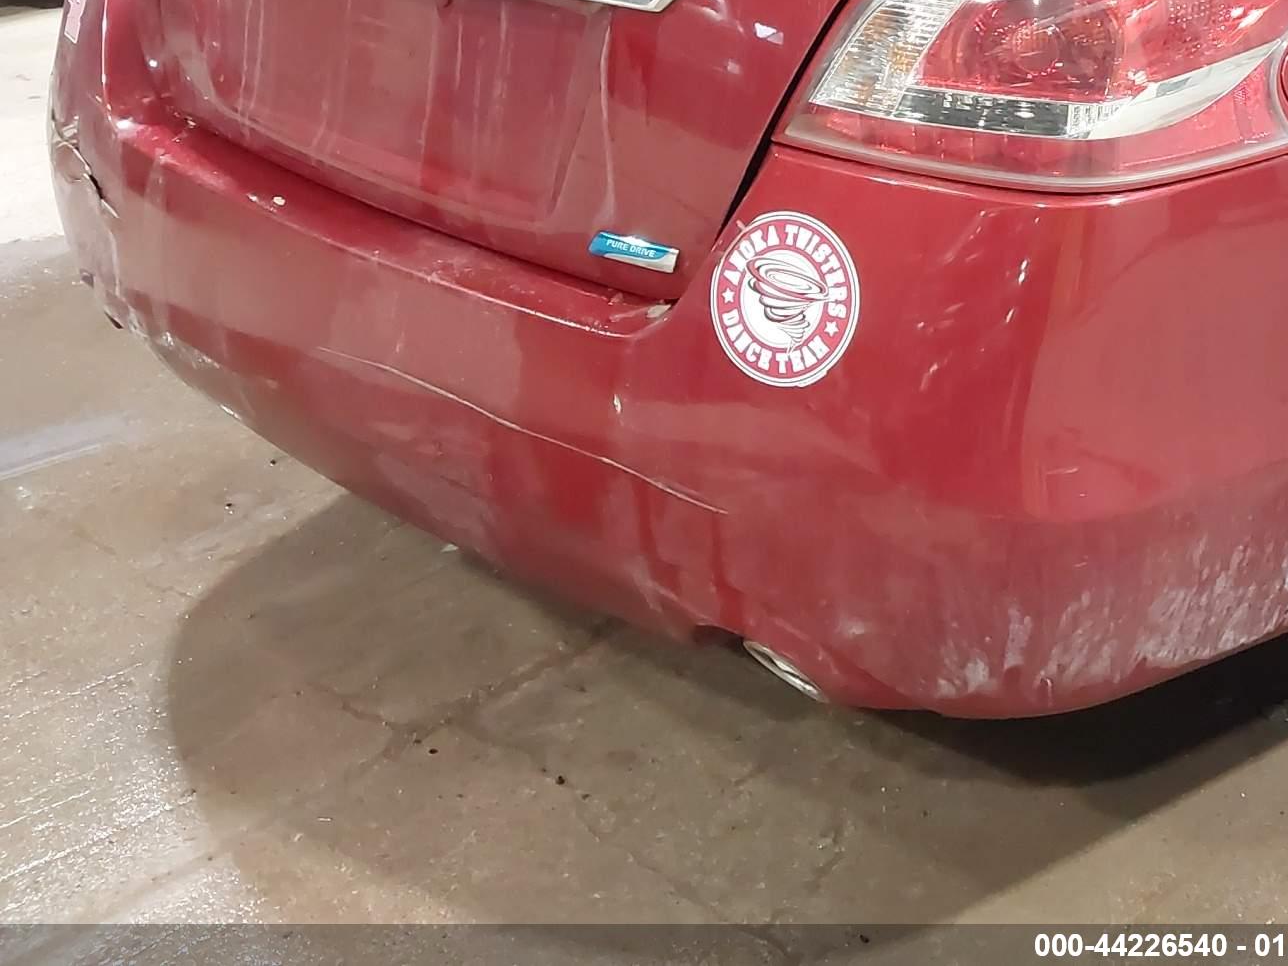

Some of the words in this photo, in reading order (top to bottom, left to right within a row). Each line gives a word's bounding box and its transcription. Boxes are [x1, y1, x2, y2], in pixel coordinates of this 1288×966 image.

[606, 238, 629, 251] PURE
[629, 245, 657, 258] DRIVE
[724, 225, 780, 286] ANOKA
[784, 224, 848, 319] TWISTERS
[722, 309, 773, 371] DANCE
[775, 335, 830, 374] TEAM
